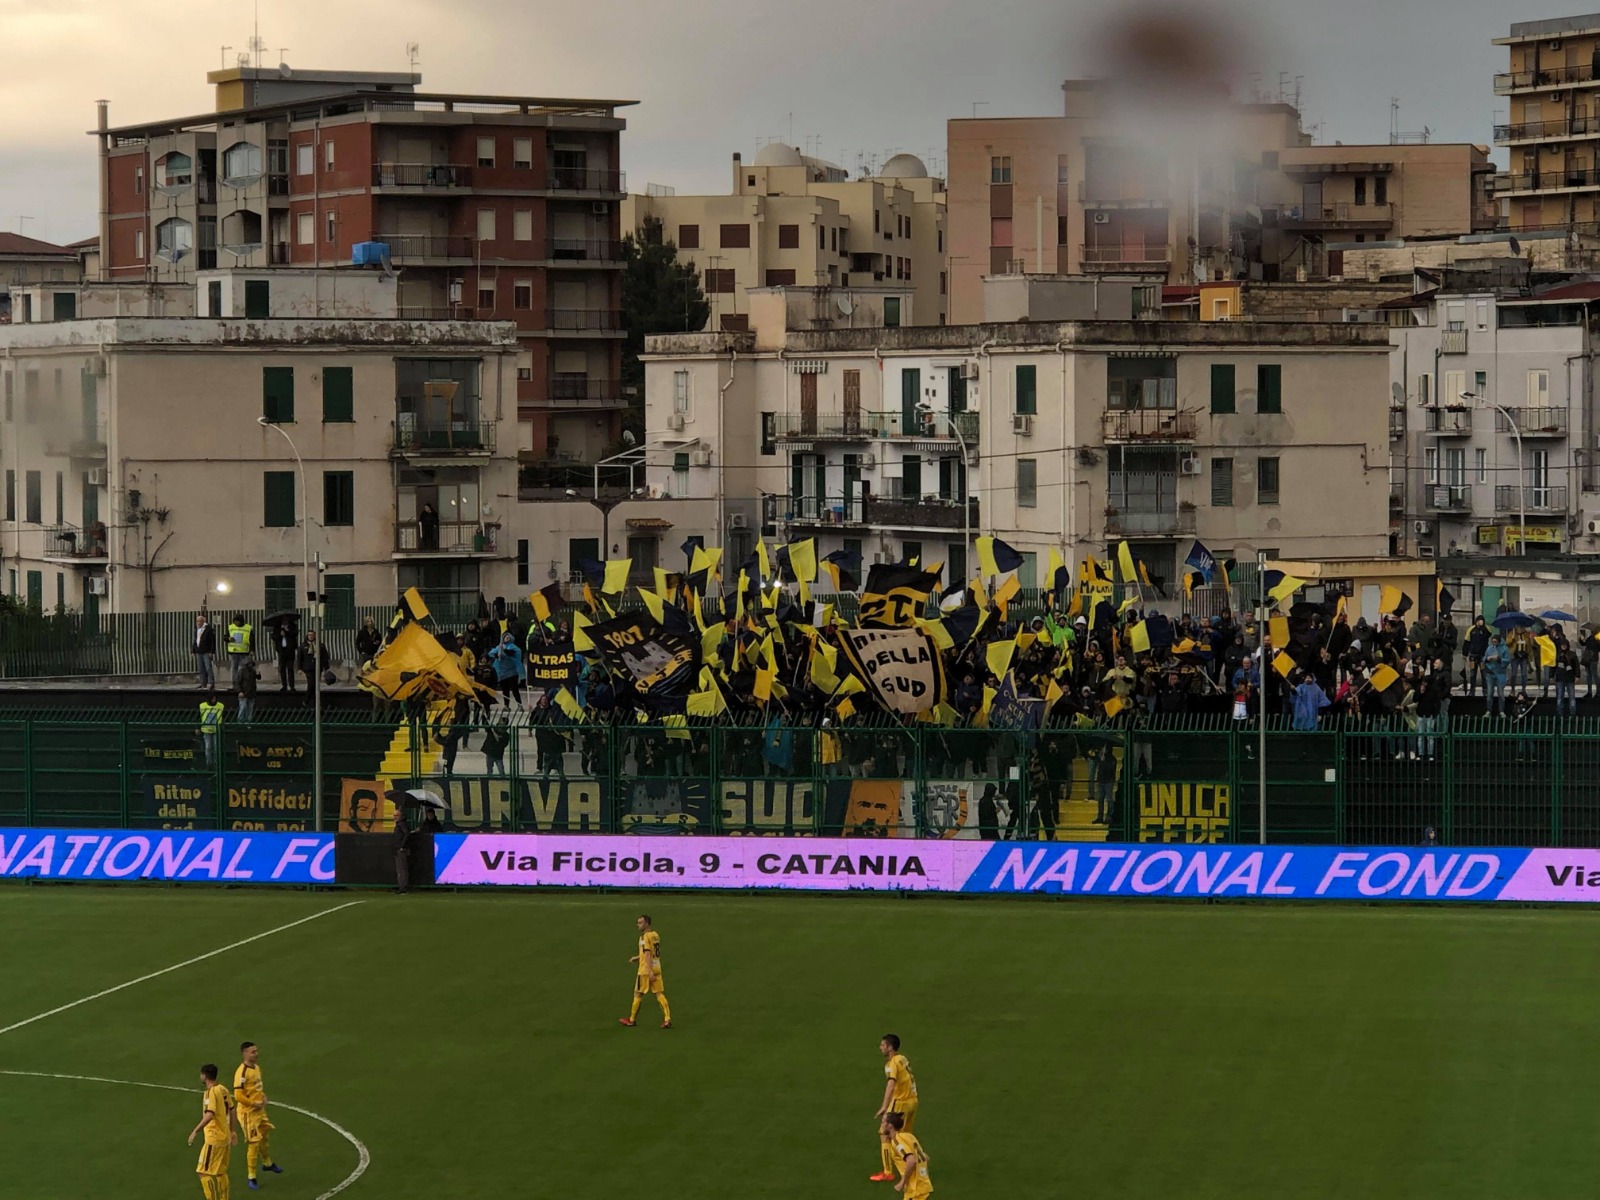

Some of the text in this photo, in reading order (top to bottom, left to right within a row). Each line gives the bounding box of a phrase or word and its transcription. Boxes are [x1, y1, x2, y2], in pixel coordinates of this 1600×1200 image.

[603, 625, 645, 649] 1907
[529, 652, 574, 666] ULTRAS
[866, 646, 931, 675] DELLA
[534, 668, 569, 680] LIBERI
[881, 676, 927, 698] SUD
[239, 745, 262, 758] NO
[154, 784, 202, 800] Ritmo
[228, 787, 312, 810] Diffidati
[1139, 783, 1230, 817] UNICA
[158, 803, 197, 818] della
[721, 780, 827, 830] SUD
[232, 819, 305, 832] con noi
[480, 850, 538, 871] Via
[552, 851, 686, 876] Ficiola,
[699, 852, 720, 874] 9
[756, 853, 926, 877] CATANIA
[989, 848, 1501, 897] NATIONAL FOND
